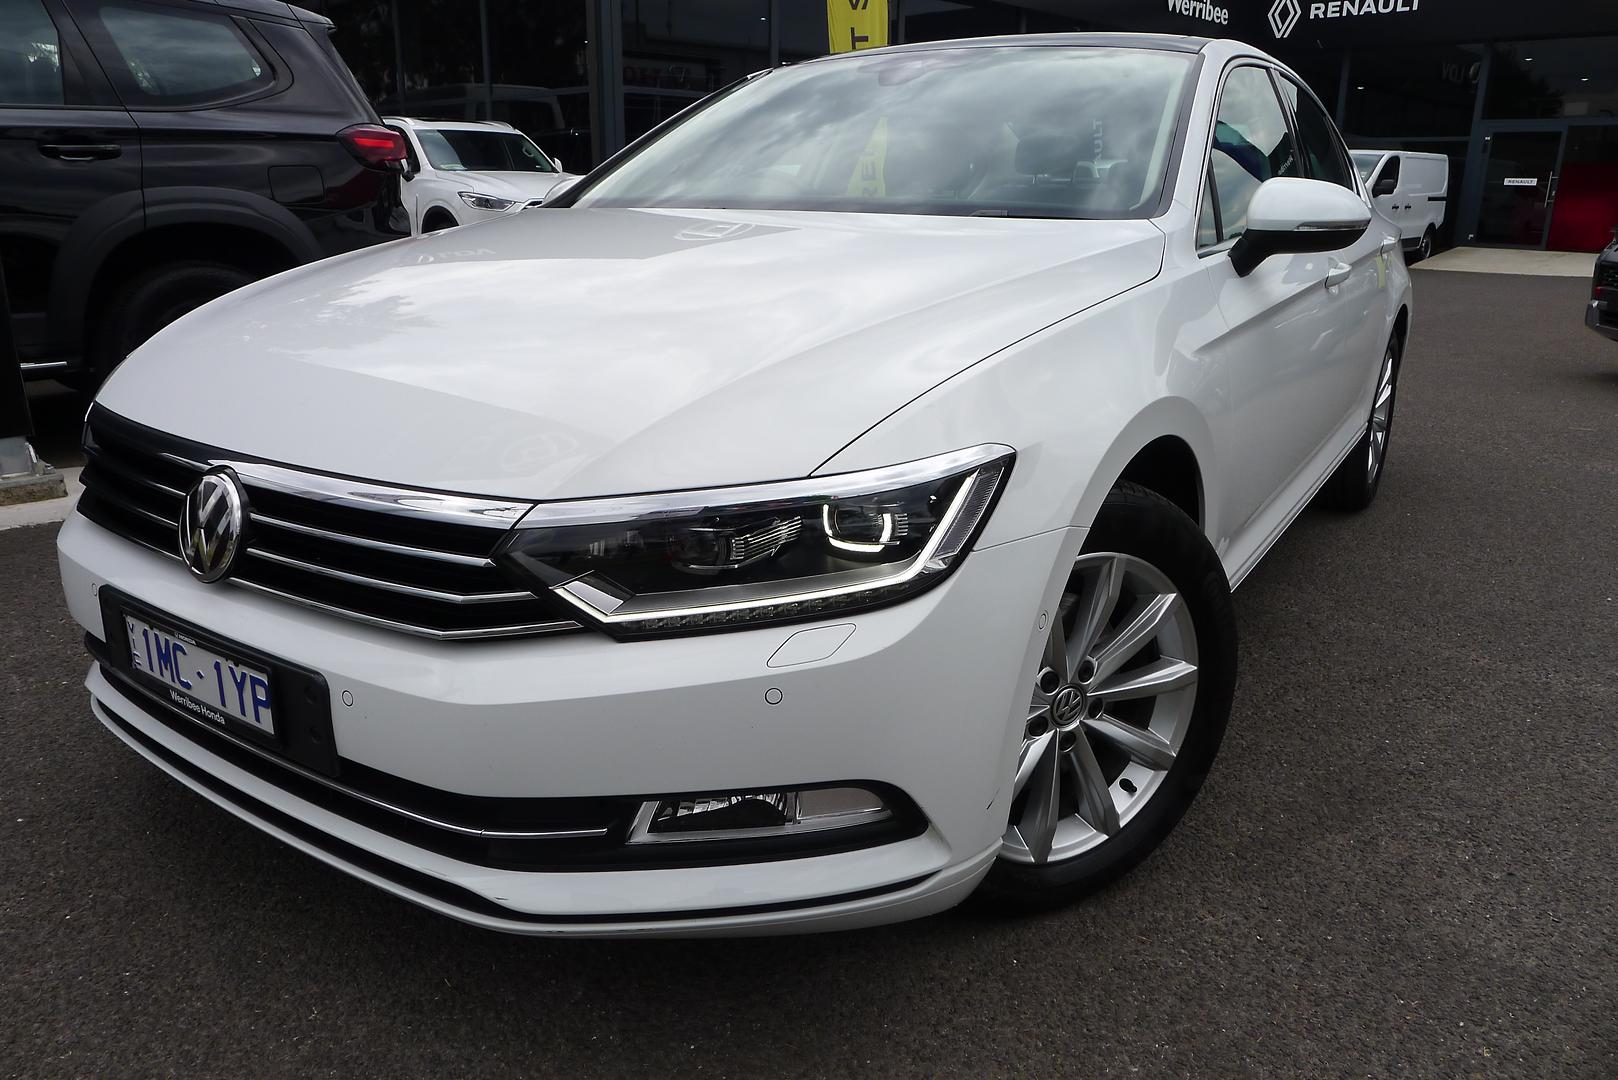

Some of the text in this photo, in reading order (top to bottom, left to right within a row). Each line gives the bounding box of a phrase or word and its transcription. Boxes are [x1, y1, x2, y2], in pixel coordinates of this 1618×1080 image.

[1167, 0, 1229, 25] Werribee
[169, 689, 226, 725] Werribee Honda
